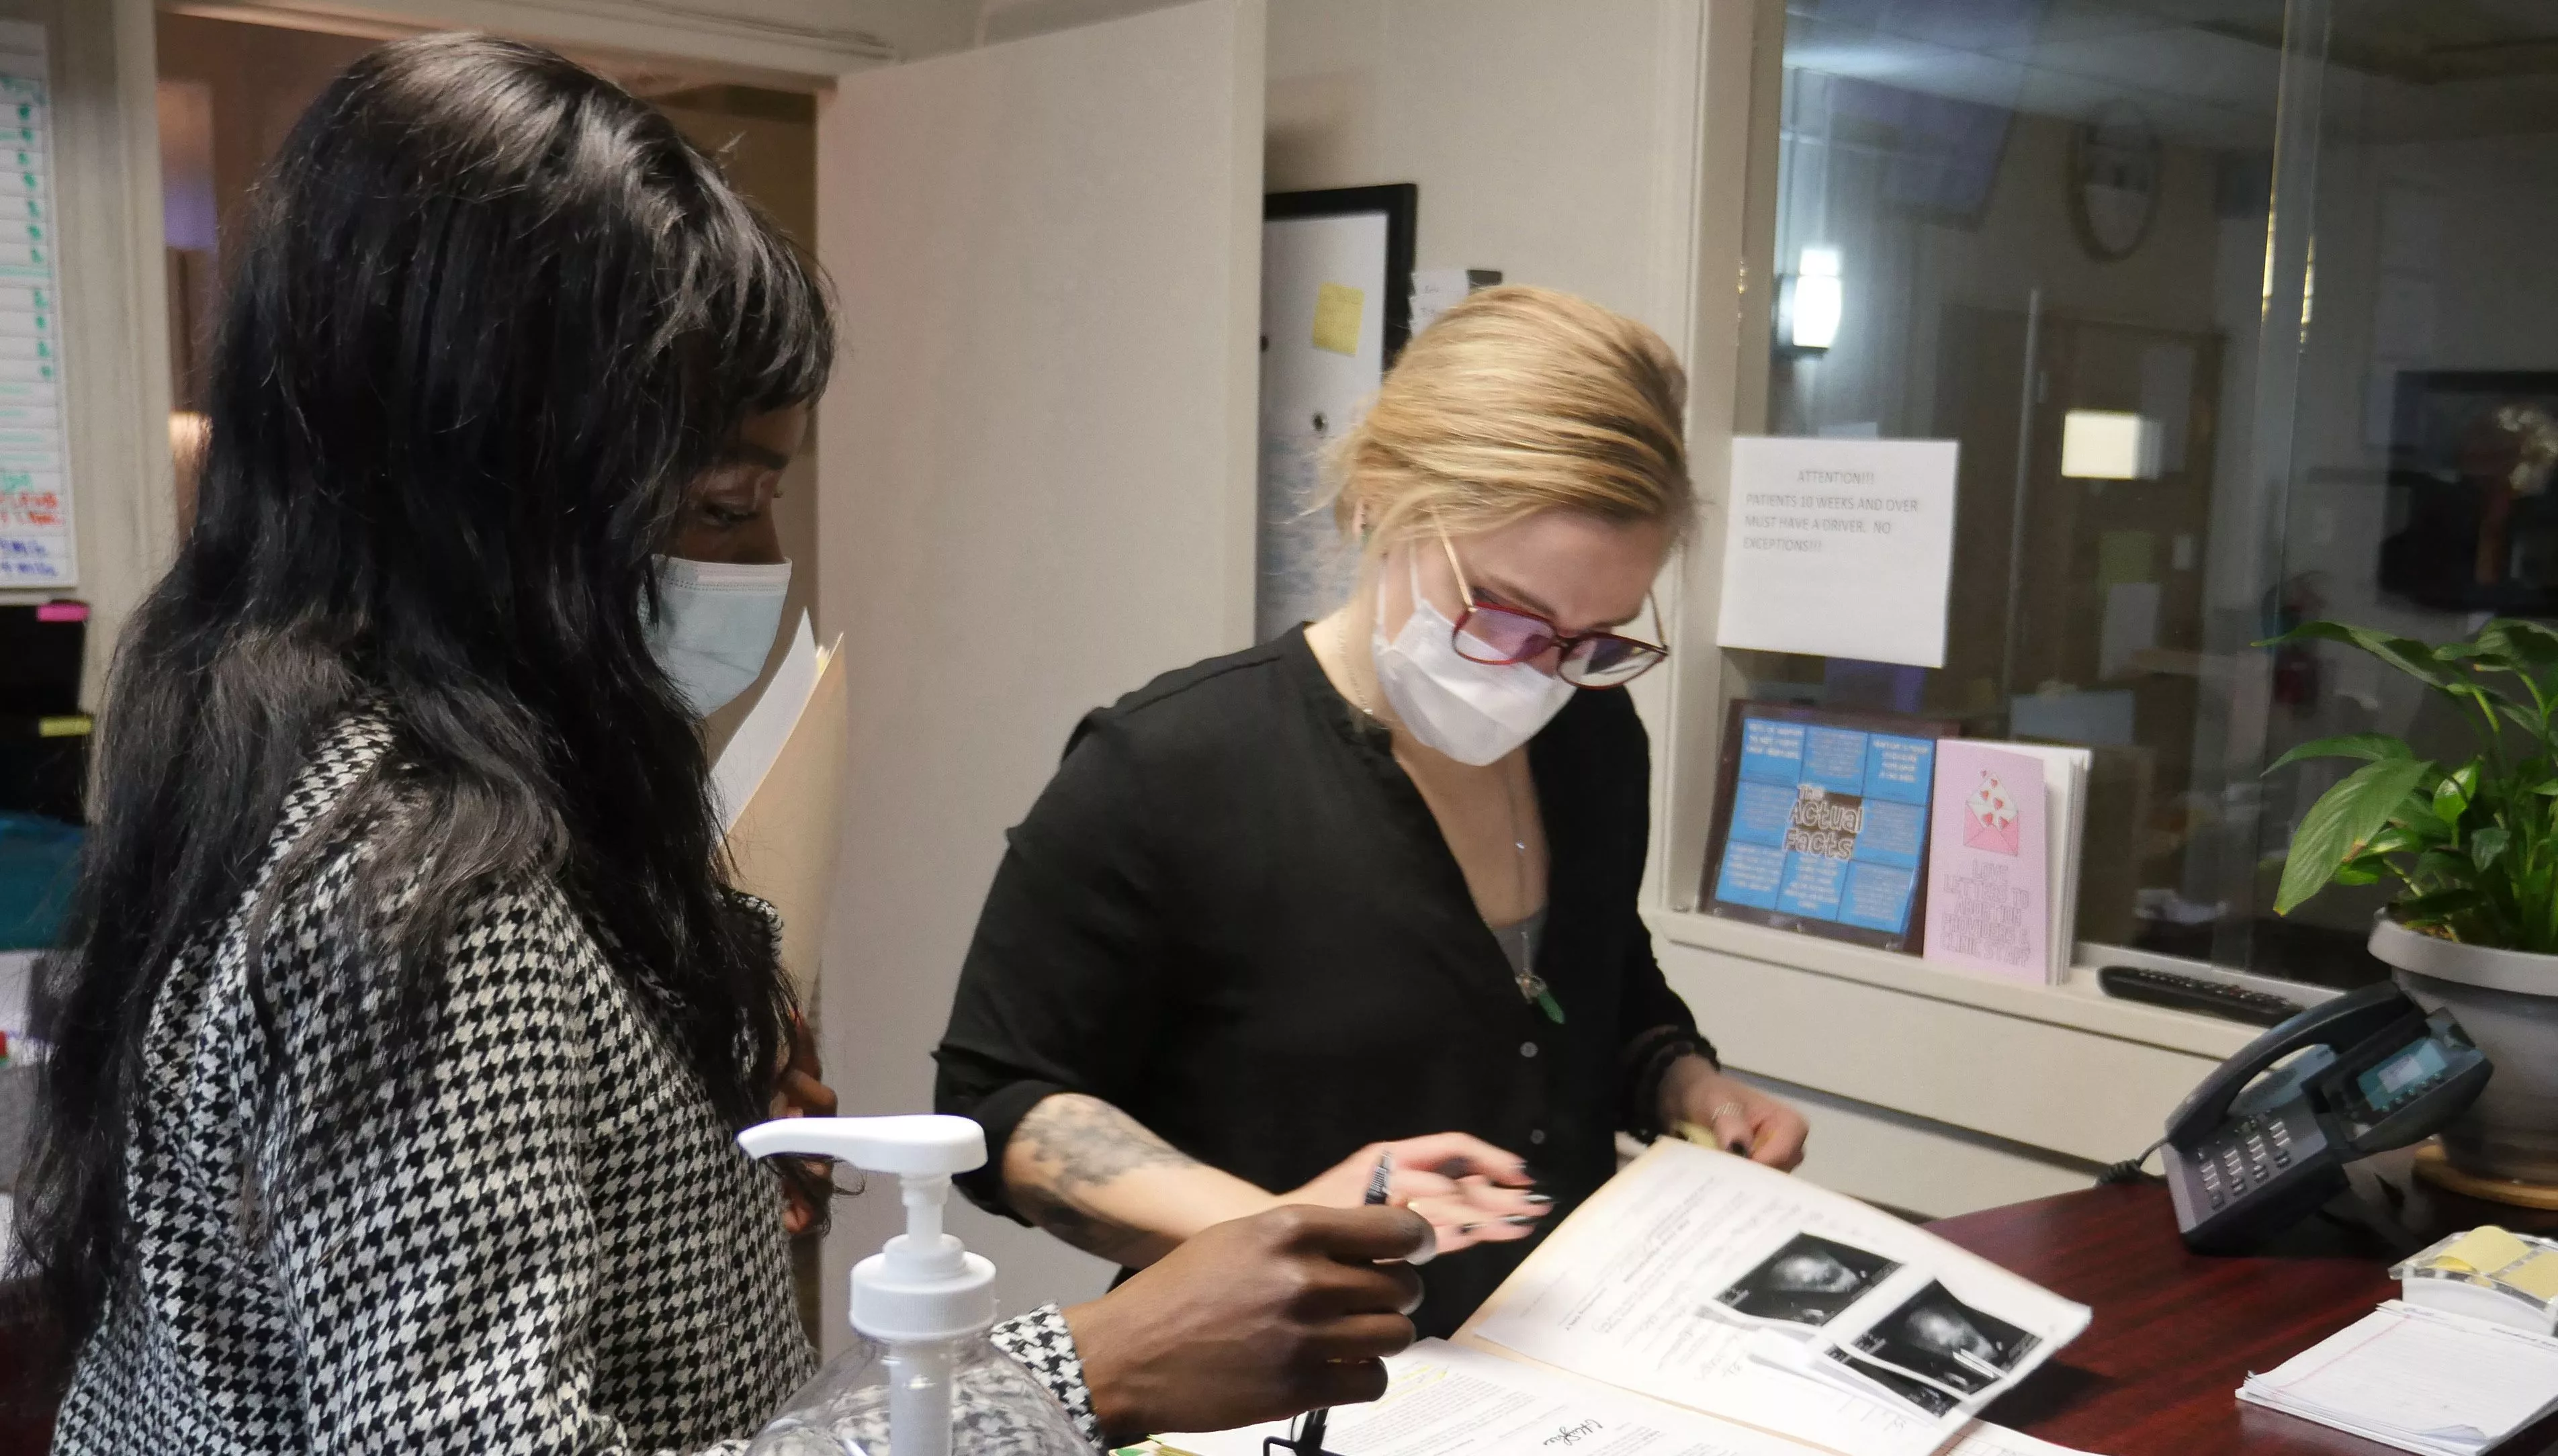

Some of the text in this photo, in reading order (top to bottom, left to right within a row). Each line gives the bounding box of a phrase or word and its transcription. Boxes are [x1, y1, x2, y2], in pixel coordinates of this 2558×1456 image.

[1797, 469, 1873, 484] ATTENTION!!!
[1746, 494, 1918, 512] PATIENTS 10 WEEKS AND OVER
[1745, 515, 1891, 535] MUST HAVE A DRIVER. NO
[1743, 537, 1822, 551] EXCEPTIONS!!!
[1972, 858, 2009, 884] LOVE
[1943, 874, 2030, 909] LETTERS TO
[1953, 897, 2021, 926] ABORTION
[1941, 912, 2014, 944] PROVIDERS
[1940, 931, 2031, 967] CLINIC STAFF
